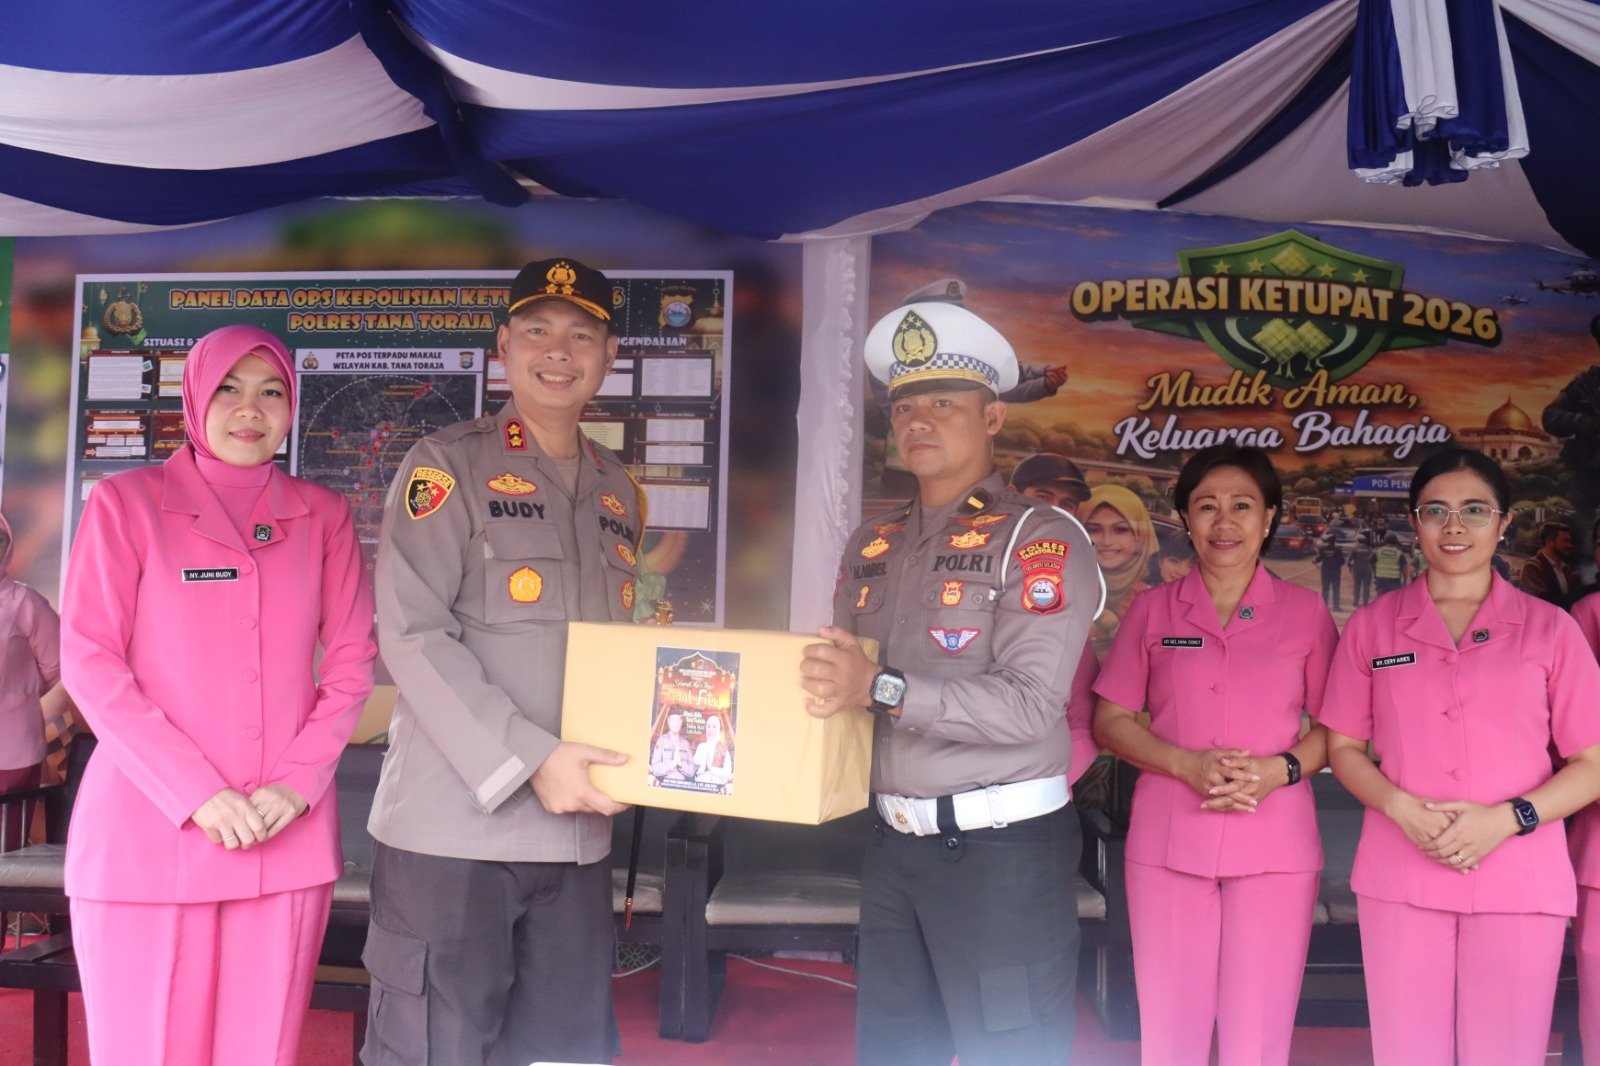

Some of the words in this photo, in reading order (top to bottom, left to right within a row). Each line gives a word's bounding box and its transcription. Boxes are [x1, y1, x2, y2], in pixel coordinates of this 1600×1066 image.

[170, 288, 234, 309] PANEL
[235, 288, 290, 308] DATA
[292, 288, 333, 307] OPS
[335, 286, 458, 307] KEPOLISIAN
[1072, 277, 1229, 315] OPERASI
[1240, 277, 1394, 321] KETUPAT
[1402, 293, 1498, 341] 2026
[288, 312, 362, 332] POLRES
[363, 312, 415, 332] TANA
[417, 311, 495, 332] TORAJA
[143, 338, 185, 347] SITUASI
[186, 338, 195, 347] &
[409, 351, 442, 359] MAKALE
[333, 362, 370, 370] WILAYAH
[371, 362, 389, 370] KAB.
[390, 362, 413, 370] TANA
[413, 362, 444, 370] TORAJA
[1137, 369, 1273, 411] Mudik
[1282, 368, 1418, 409] Aman,
[1292, 409, 1451, 459] Bahagia
[416, 469, 453, 488] RESERSE
[1371, 478, 1389, 488] POS
[488, 500, 546, 520] BUDY
[1018, 542, 1066, 557] POLRES
[932, 554, 994, 574] POLRI
